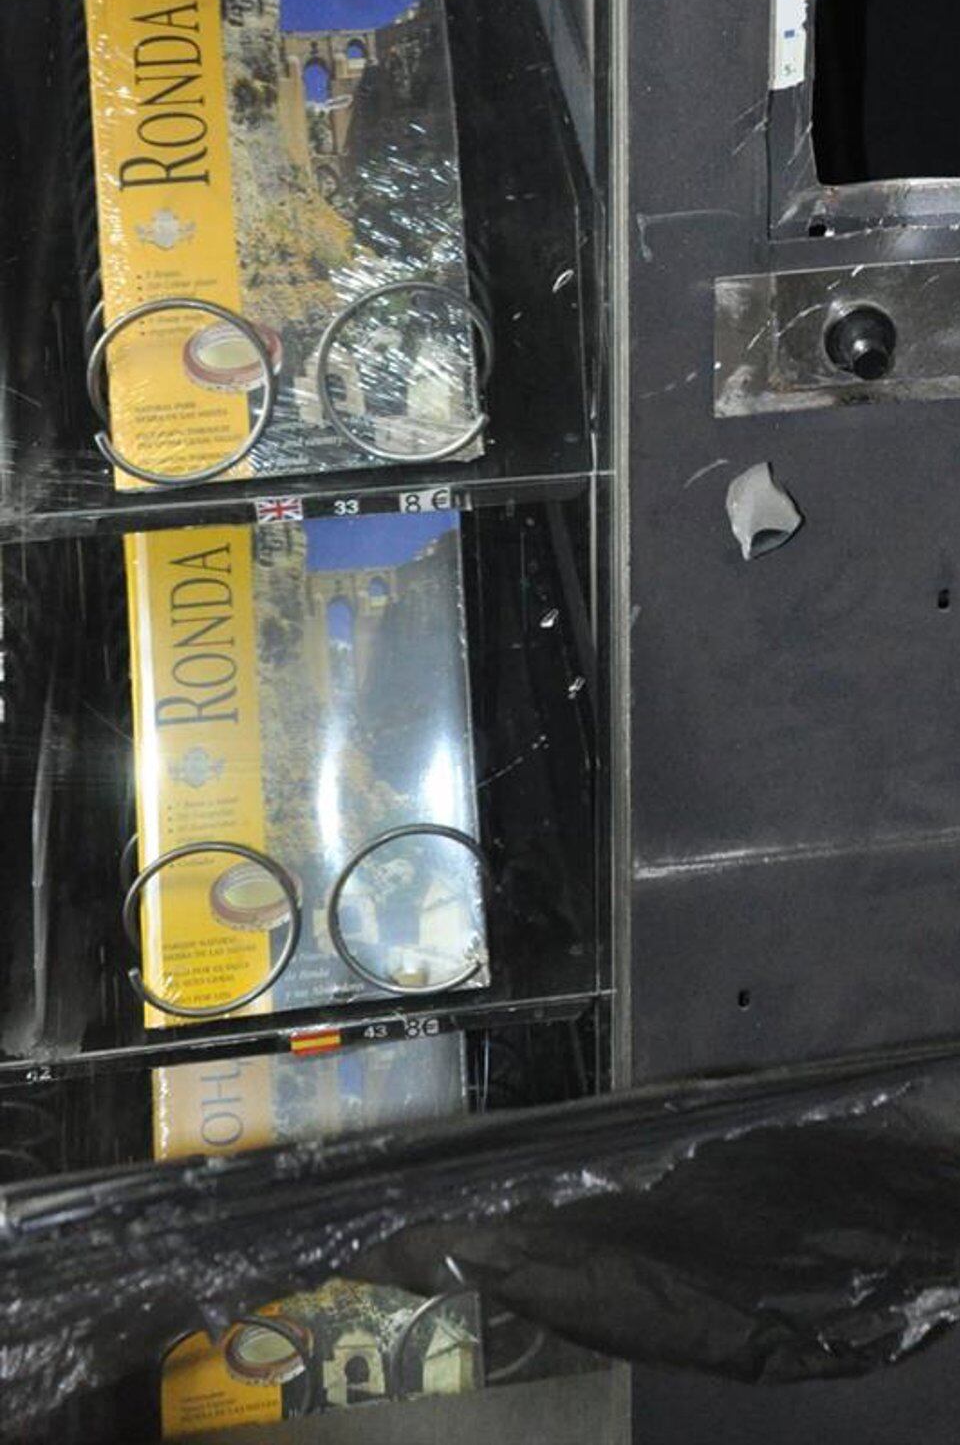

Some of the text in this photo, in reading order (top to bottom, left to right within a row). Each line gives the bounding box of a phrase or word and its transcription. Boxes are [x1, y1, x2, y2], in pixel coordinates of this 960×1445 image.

[118, 0, 211, 192] RONDA
[334, 500, 360, 515] 33
[155, 541, 240, 729] RONDA
[363, 1025, 389, 1038] 43
